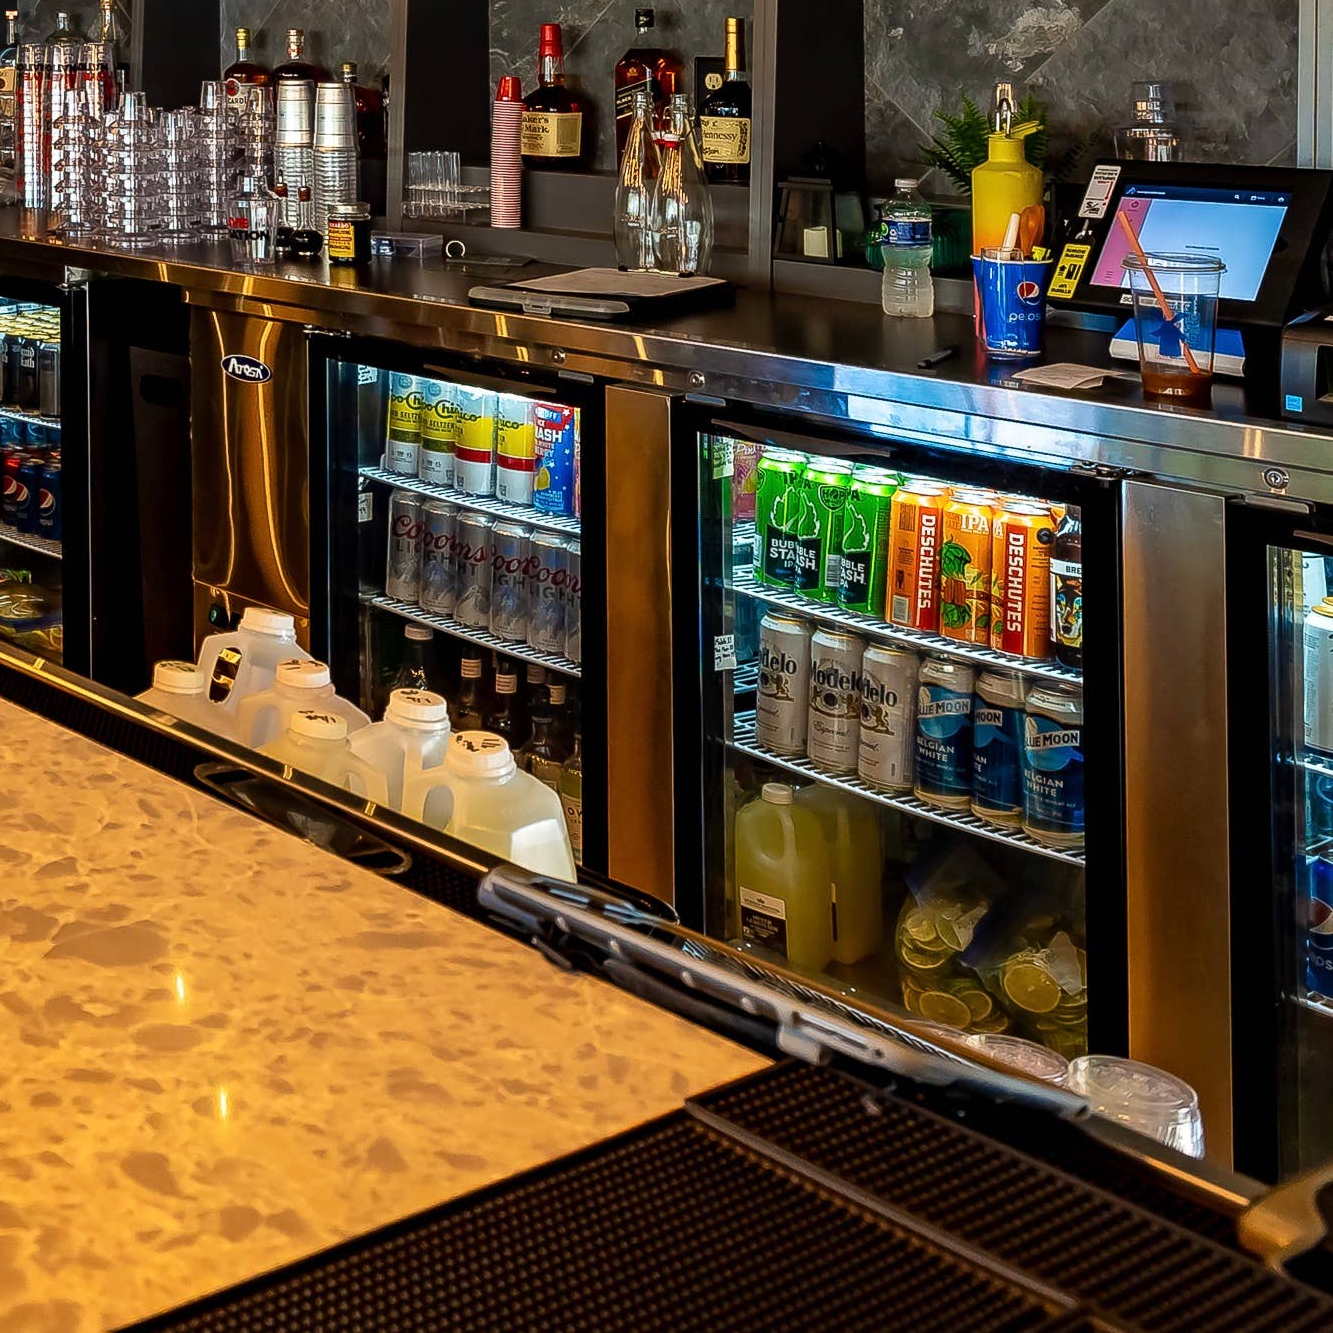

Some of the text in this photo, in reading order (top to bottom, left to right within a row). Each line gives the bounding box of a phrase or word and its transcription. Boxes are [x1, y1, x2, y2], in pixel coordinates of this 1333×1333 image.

[522, 115, 549, 124] aker's
[534, 426, 563, 443] ASH
[960, 513, 989, 533] IPA
[841, 557, 865, 573] BBLE
[917, 514, 936, 610] DESCHUTES
[1006, 532, 1025, 633] DESCHUTES
[762, 649, 797, 675] delo
[863, 675, 898, 708] delo
[935, 698, 970, 714] MOON
[1042, 731, 1079, 748] MOON
